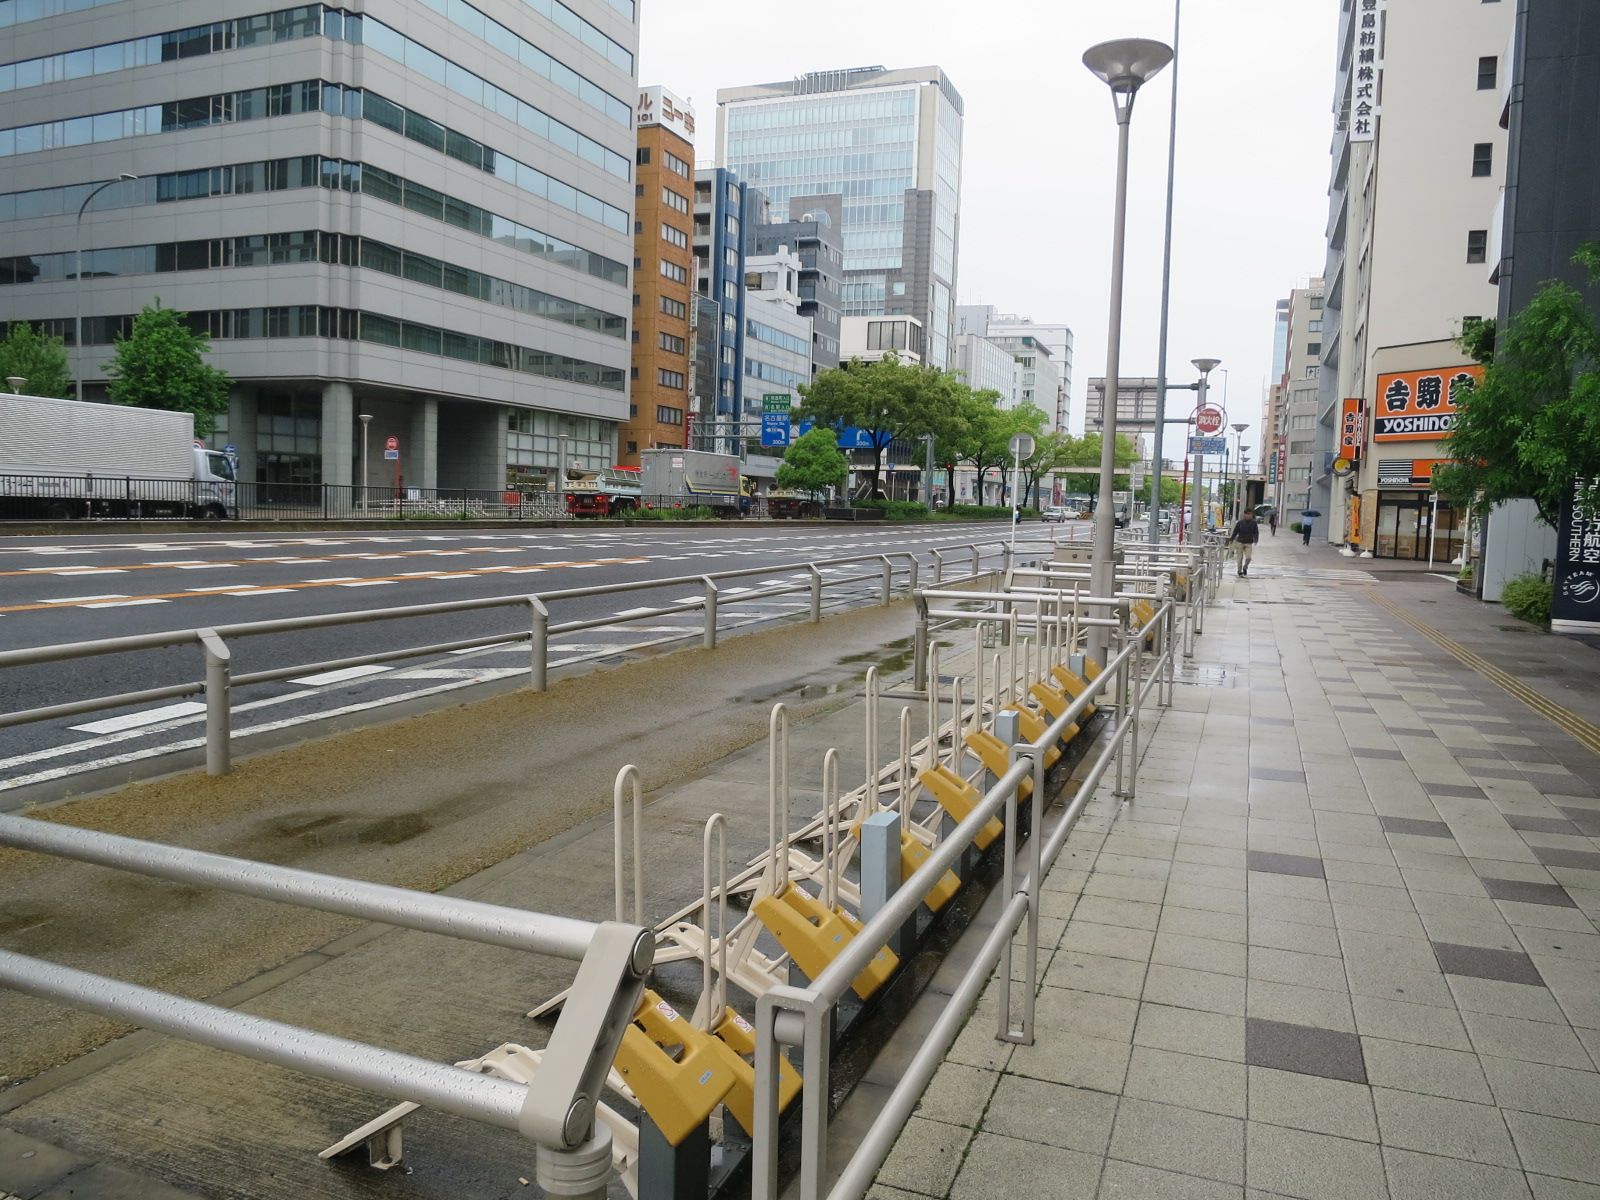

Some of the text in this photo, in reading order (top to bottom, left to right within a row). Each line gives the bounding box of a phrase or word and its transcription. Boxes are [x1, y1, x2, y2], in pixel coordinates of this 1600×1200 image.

[1198, 415, 1220, 426] 消火栓
[1344, 411, 1355, 446] 吉野家
[1383, 415, 1459, 433] YOSHINO
[1568, 504, 1584, 562] SOUTHERN
[1562, 570, 1594, 596] SKYTEAM
